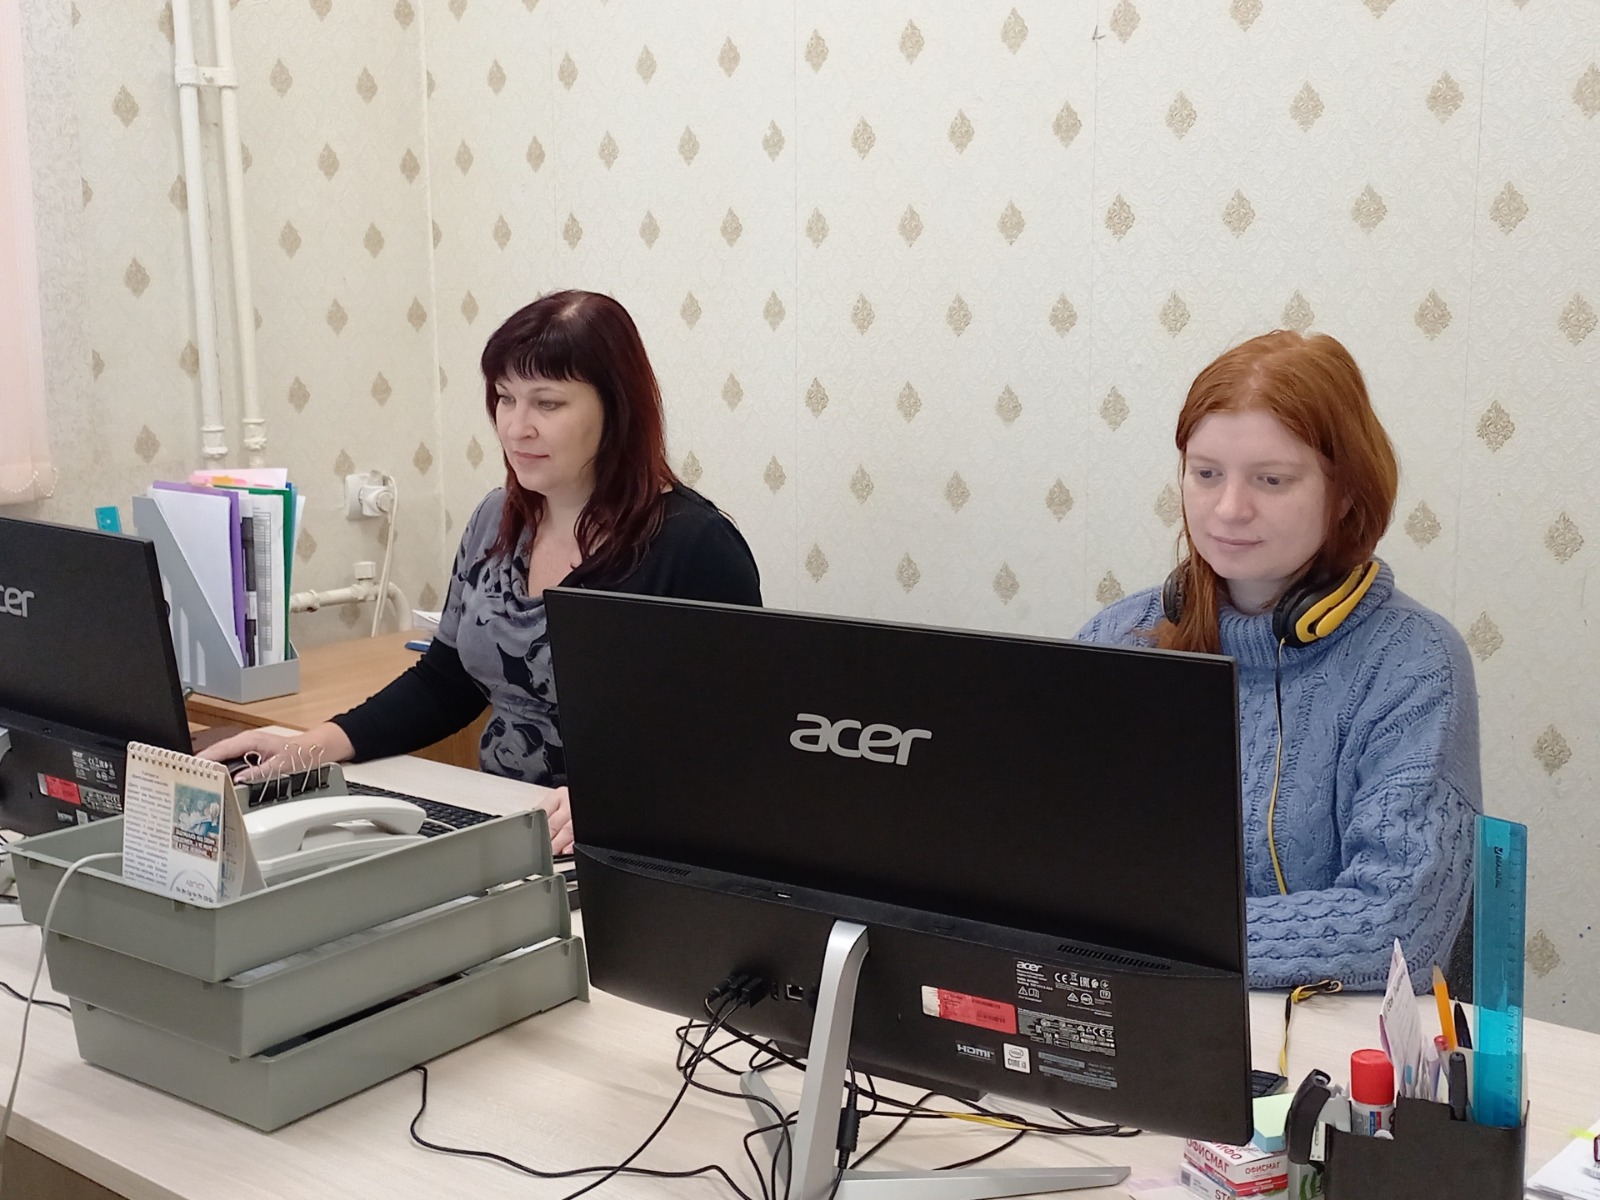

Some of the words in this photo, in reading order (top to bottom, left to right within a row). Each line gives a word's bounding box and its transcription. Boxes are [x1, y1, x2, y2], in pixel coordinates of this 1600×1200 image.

[789, 713, 933, 766] acer
[1016, 961, 1043, 972] acer
[956, 1043, 991, 1058] HDMI
[1186, 1139, 1229, 1174] ОФИСМАГ
[1245, 1161, 1281, 1175] ОФИСМАГ
